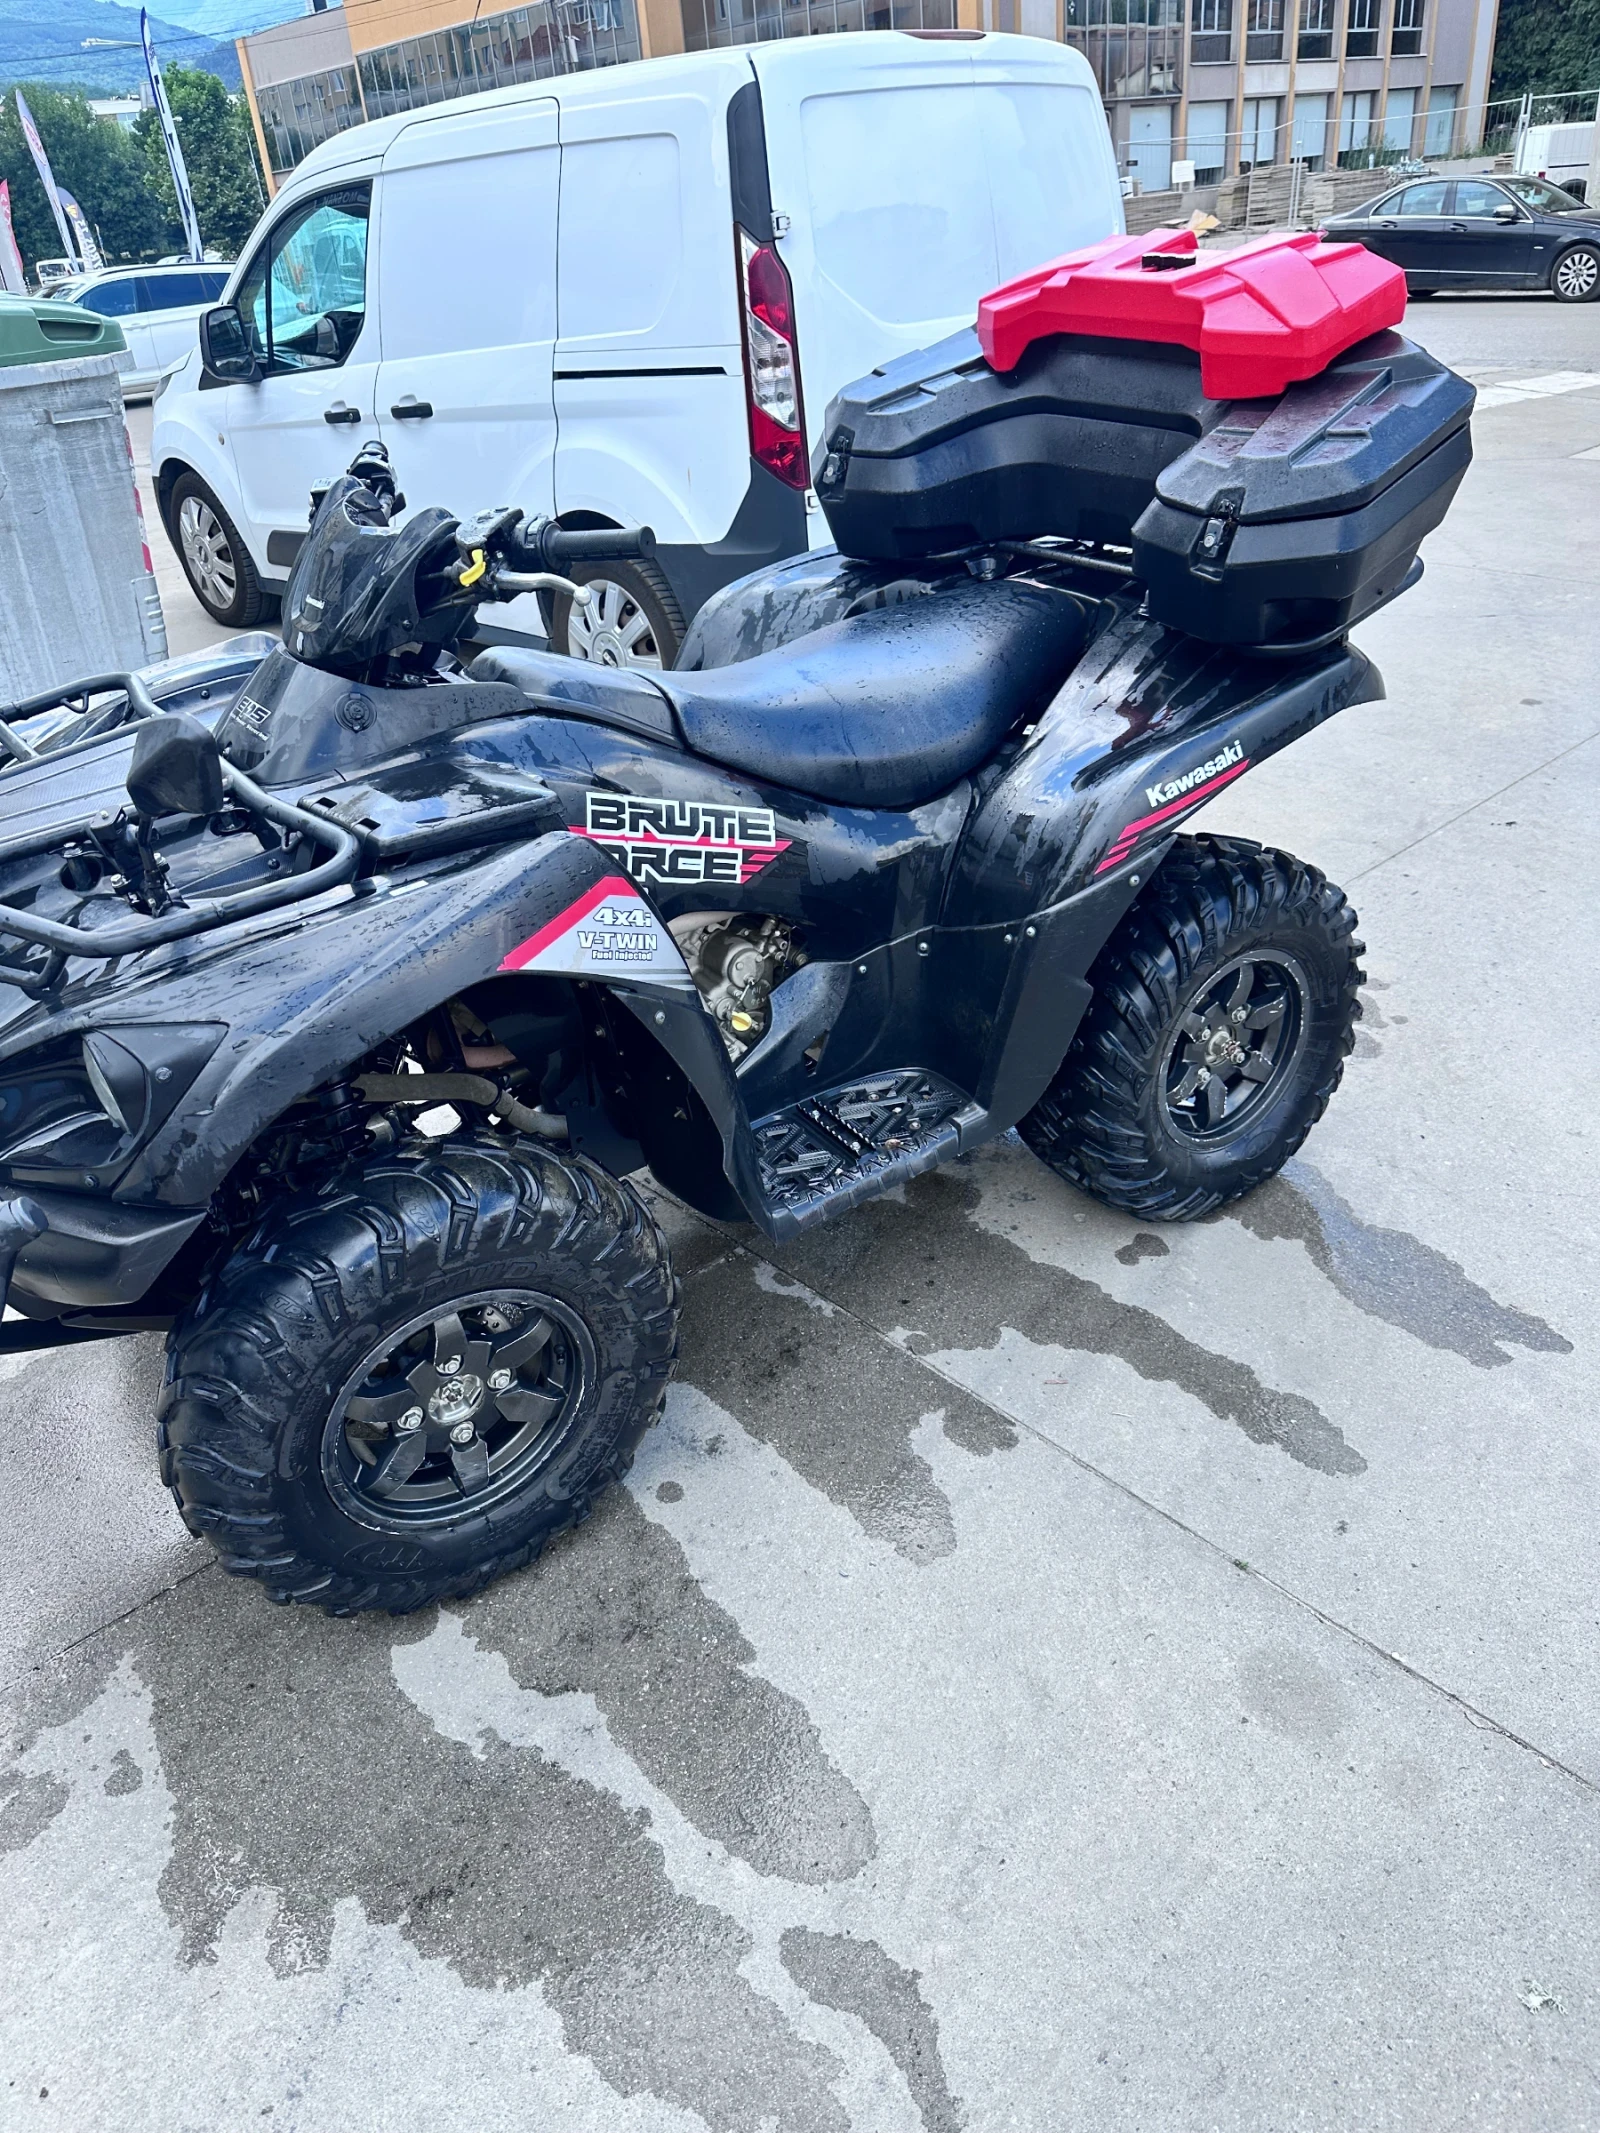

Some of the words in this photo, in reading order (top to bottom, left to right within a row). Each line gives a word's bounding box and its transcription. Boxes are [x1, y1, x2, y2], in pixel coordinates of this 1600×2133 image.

[1144, 739, 1244, 808] Kawasaki
[586, 792, 776, 847] BRUTE
[596, 838, 743, 885] ORCE
[576, 930, 658, 951] V-TWIN
[591, 949, 613, 960] Fuel
[614, 950, 653, 961] Injected
